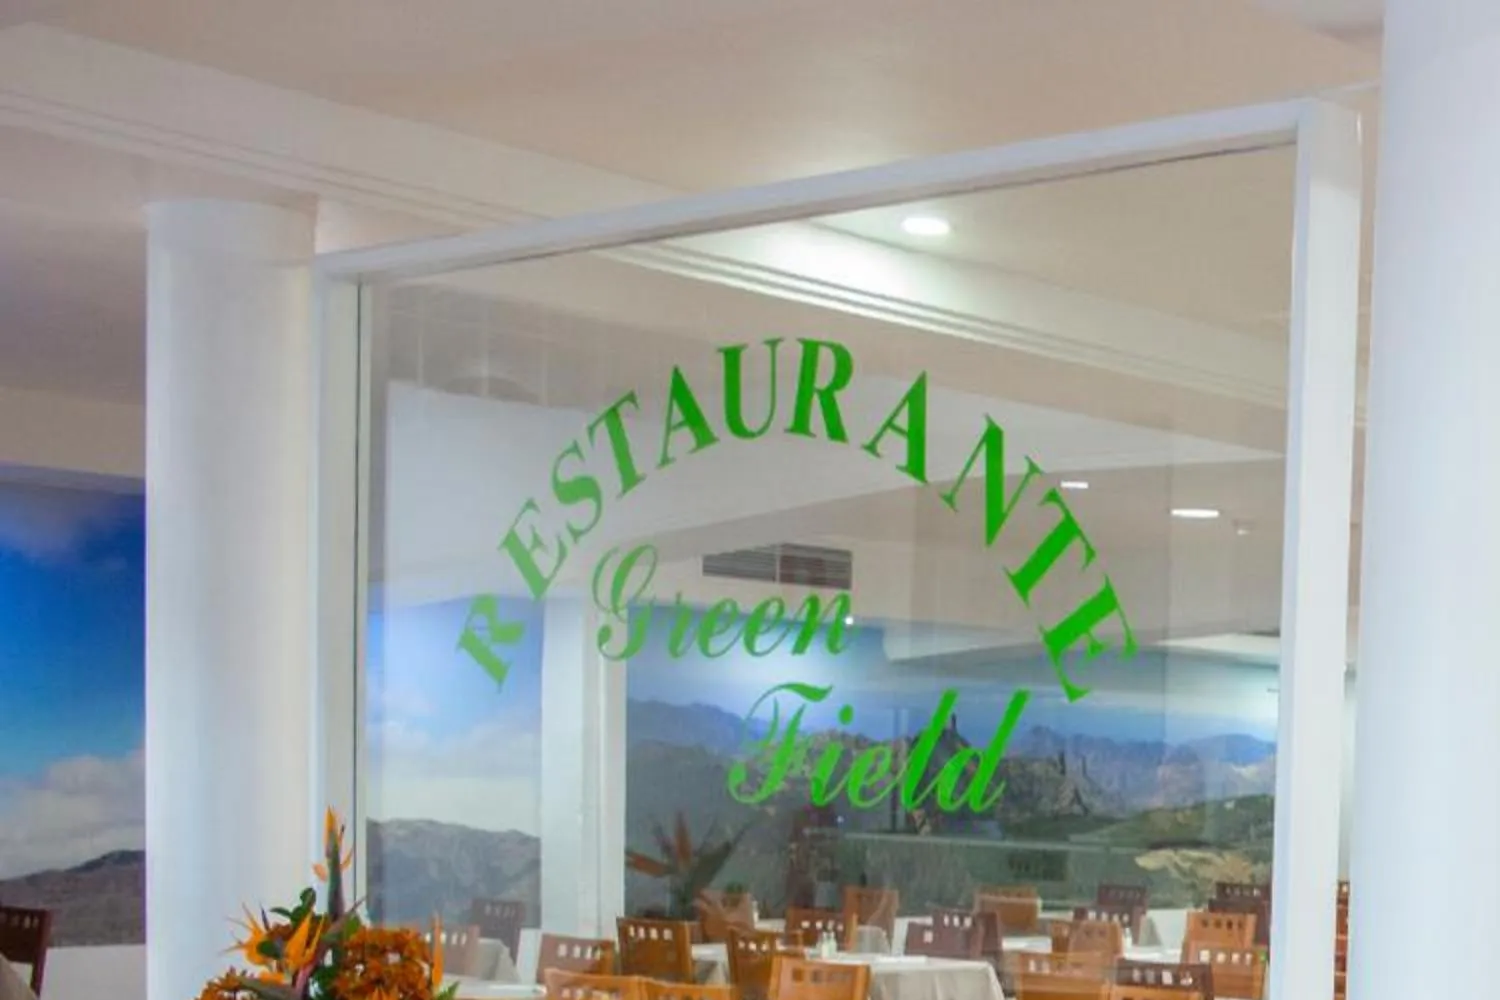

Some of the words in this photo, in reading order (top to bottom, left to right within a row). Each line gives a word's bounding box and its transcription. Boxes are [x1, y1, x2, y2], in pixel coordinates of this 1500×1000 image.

[456, 336, 1141, 704] RESTAURANTE
[592, 544, 858, 661] Green
[727, 681, 1033, 815] Field
